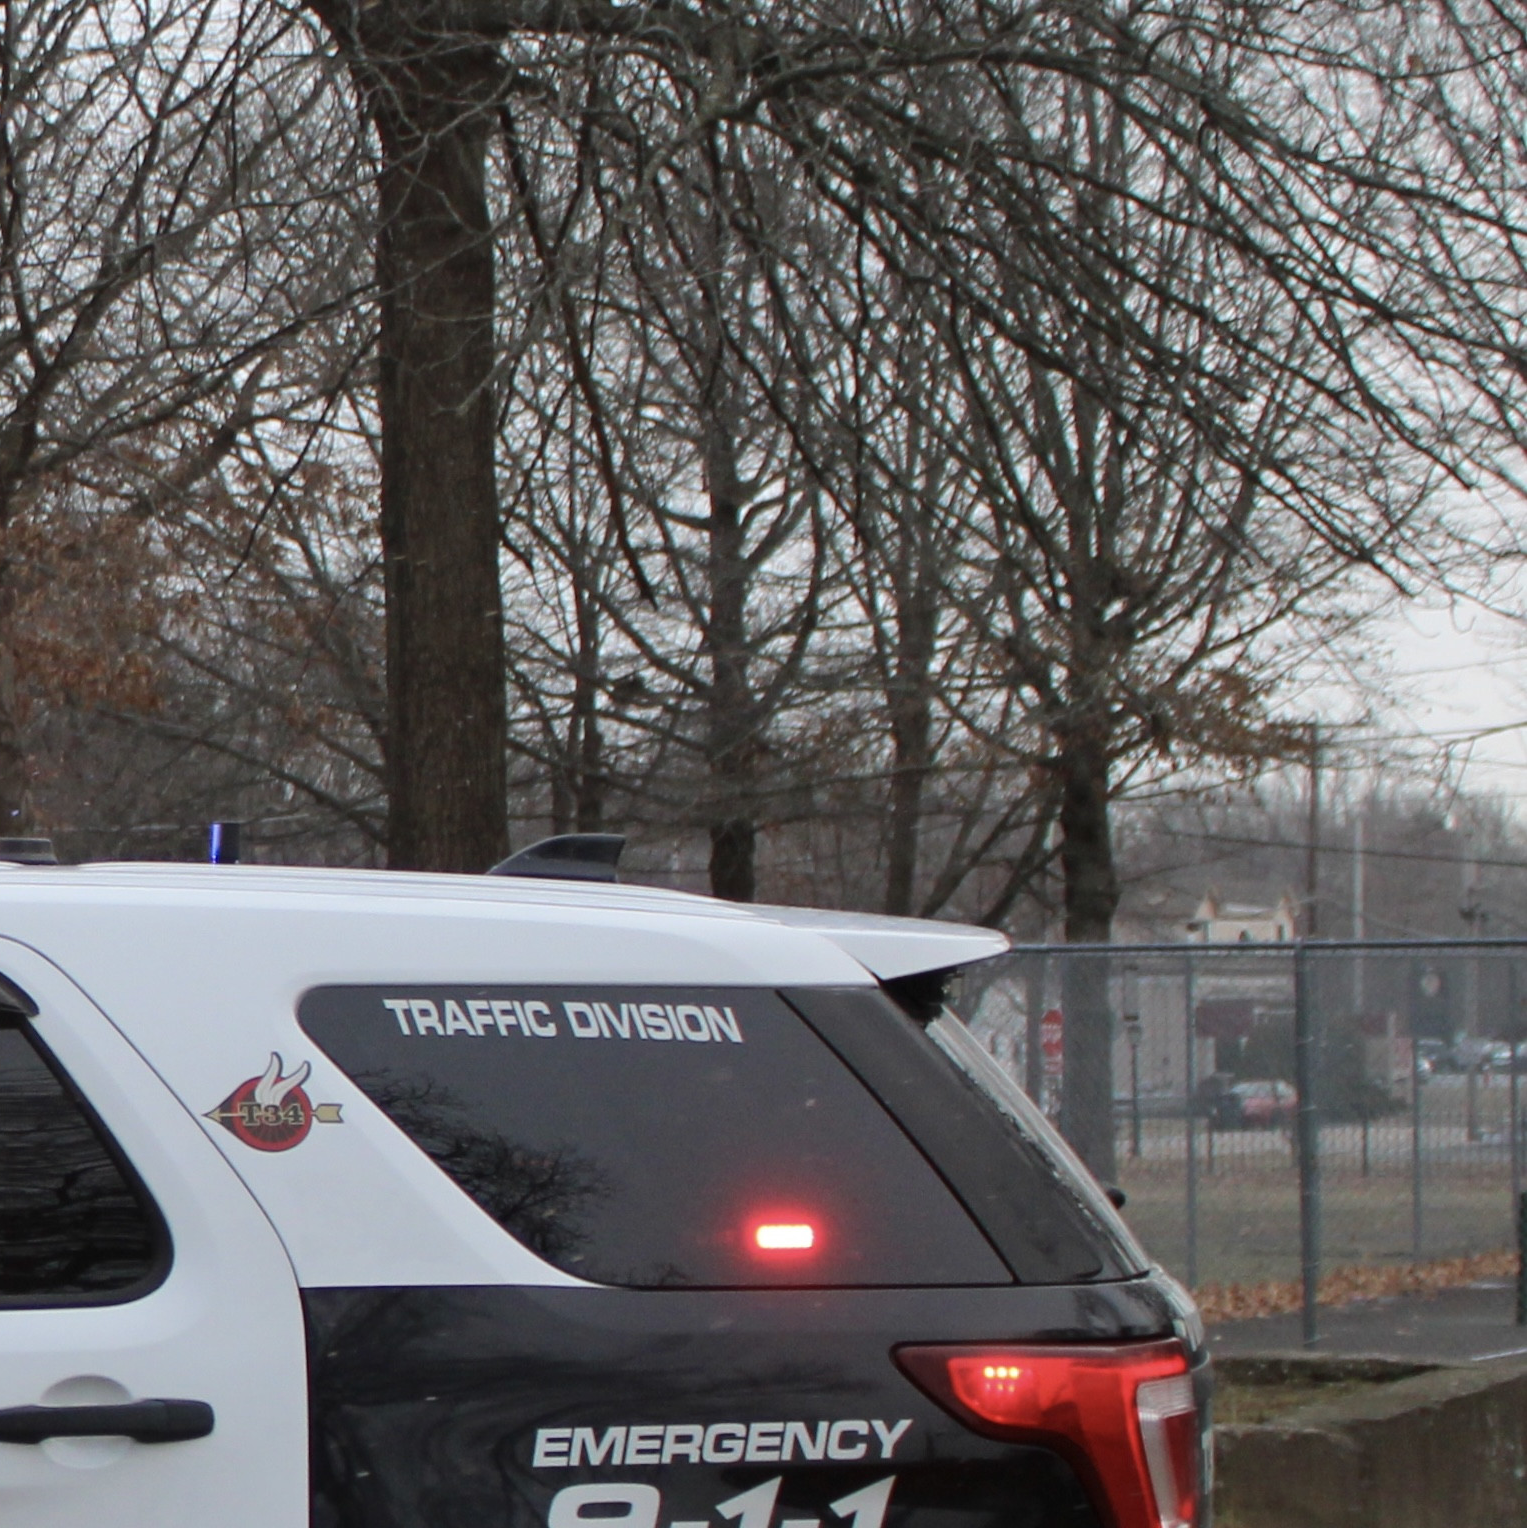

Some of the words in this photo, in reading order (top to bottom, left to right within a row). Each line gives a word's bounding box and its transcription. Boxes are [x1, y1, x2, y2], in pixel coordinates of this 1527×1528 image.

[382, 998, 557, 1038] TRAFFIC
[562, 1001, 743, 1044] DIVISION
[237, 1101, 305, 1126] T34
[532, 1418, 913, 1468] EMERGENCY
